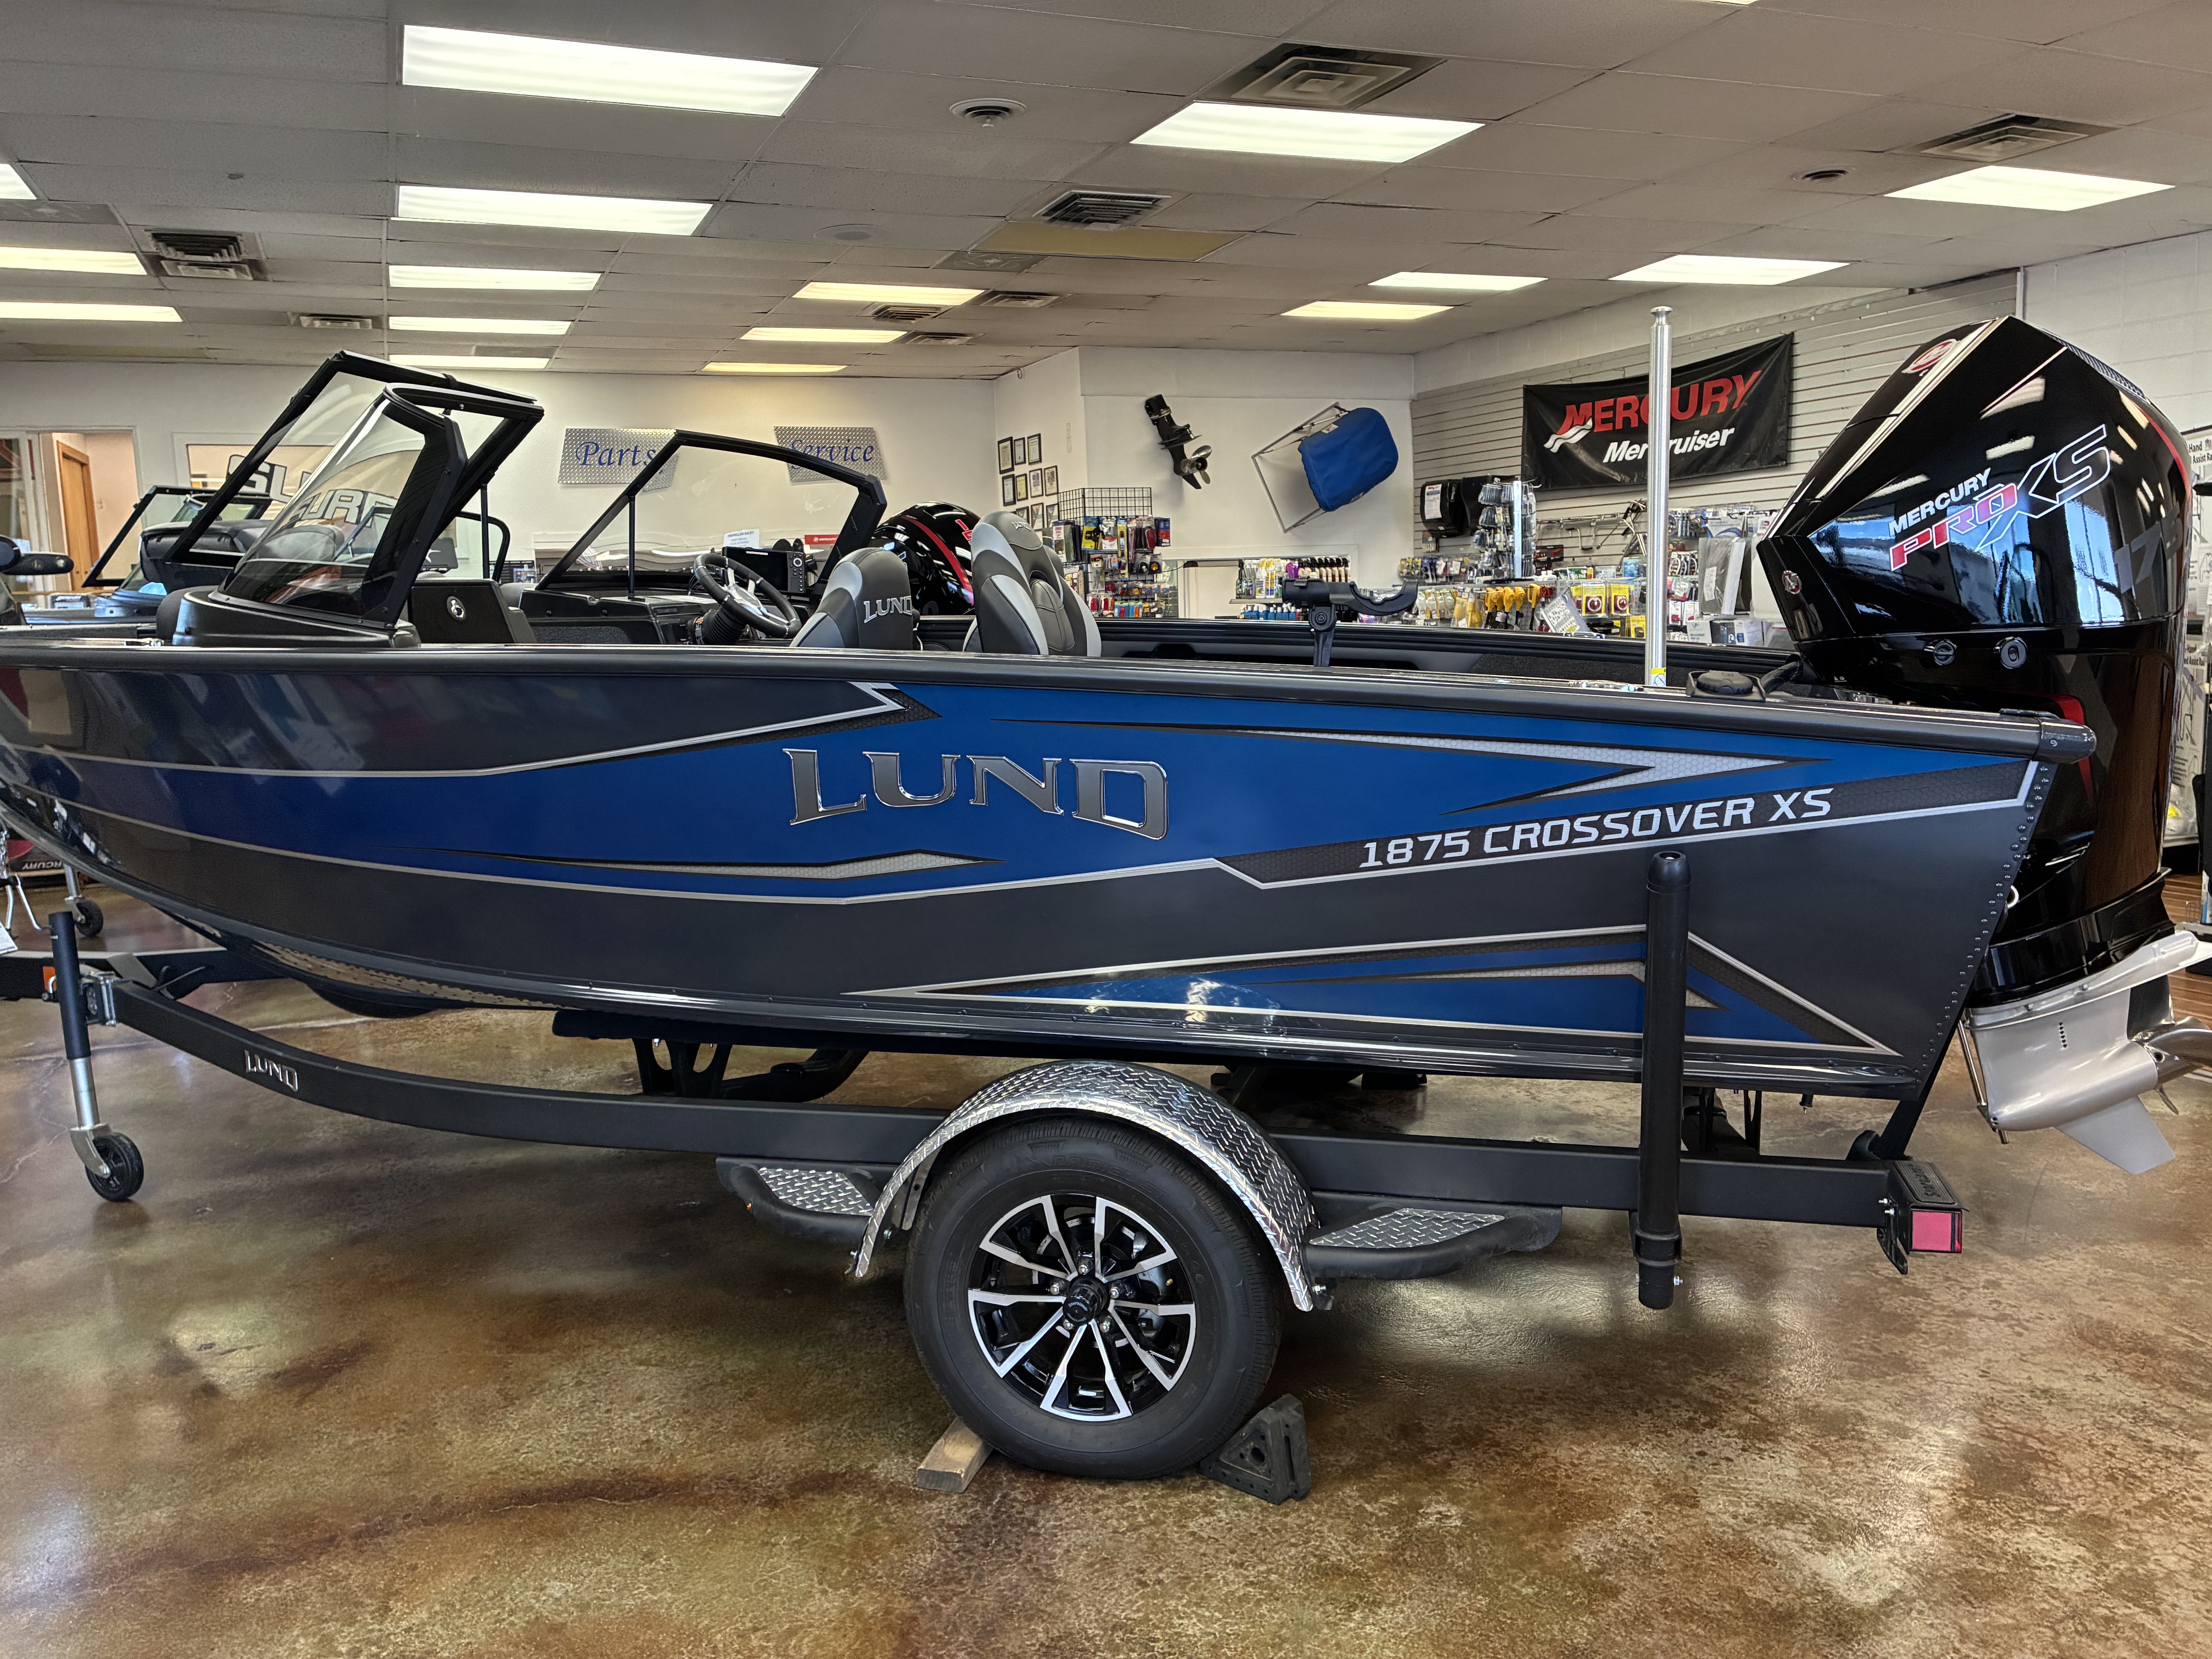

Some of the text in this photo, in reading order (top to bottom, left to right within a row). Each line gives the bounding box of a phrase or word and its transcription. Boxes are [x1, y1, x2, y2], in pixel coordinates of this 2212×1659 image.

[1603, 428, 1735, 463] Merruiser
[2189, 441, 2202, 453] Hand
[2193, 453, 2206, 464] Assist
[1889, 467, 1991, 537] MERCURY
[1890, 483, 2018, 571] PRO
[864, 595, 913, 623] LUND
[782, 748, 1168, 840] LUND
[1359, 788, 1834, 868] 1875 CROSSOVER XS
[21, 860, 62, 870] RCURY
[244, 1050, 298, 1092] LUND
